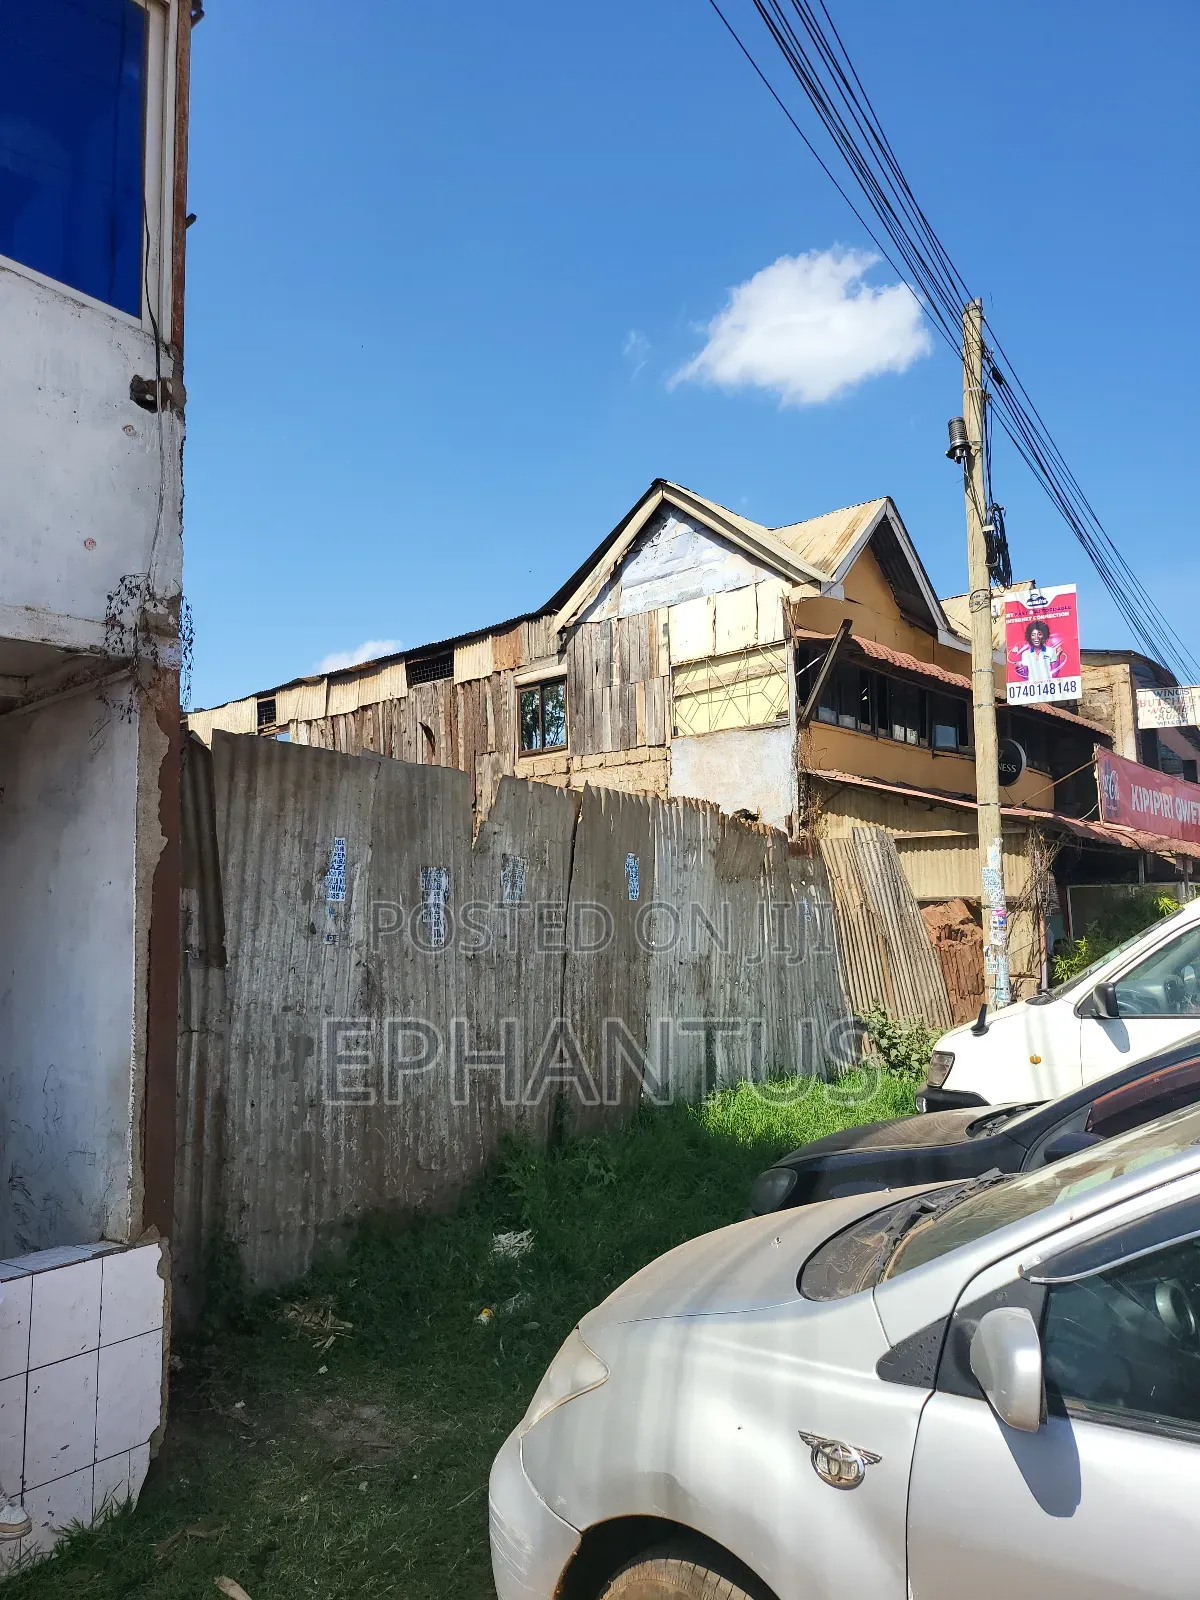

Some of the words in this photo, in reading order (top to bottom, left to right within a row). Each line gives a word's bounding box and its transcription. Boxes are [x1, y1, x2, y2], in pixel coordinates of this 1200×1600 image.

[1005, 616, 1033, 624] INTERNET
[1033, 611, 1070, 621] CONNECTION
[1131, 783, 1175, 819] KIPIPIRI
